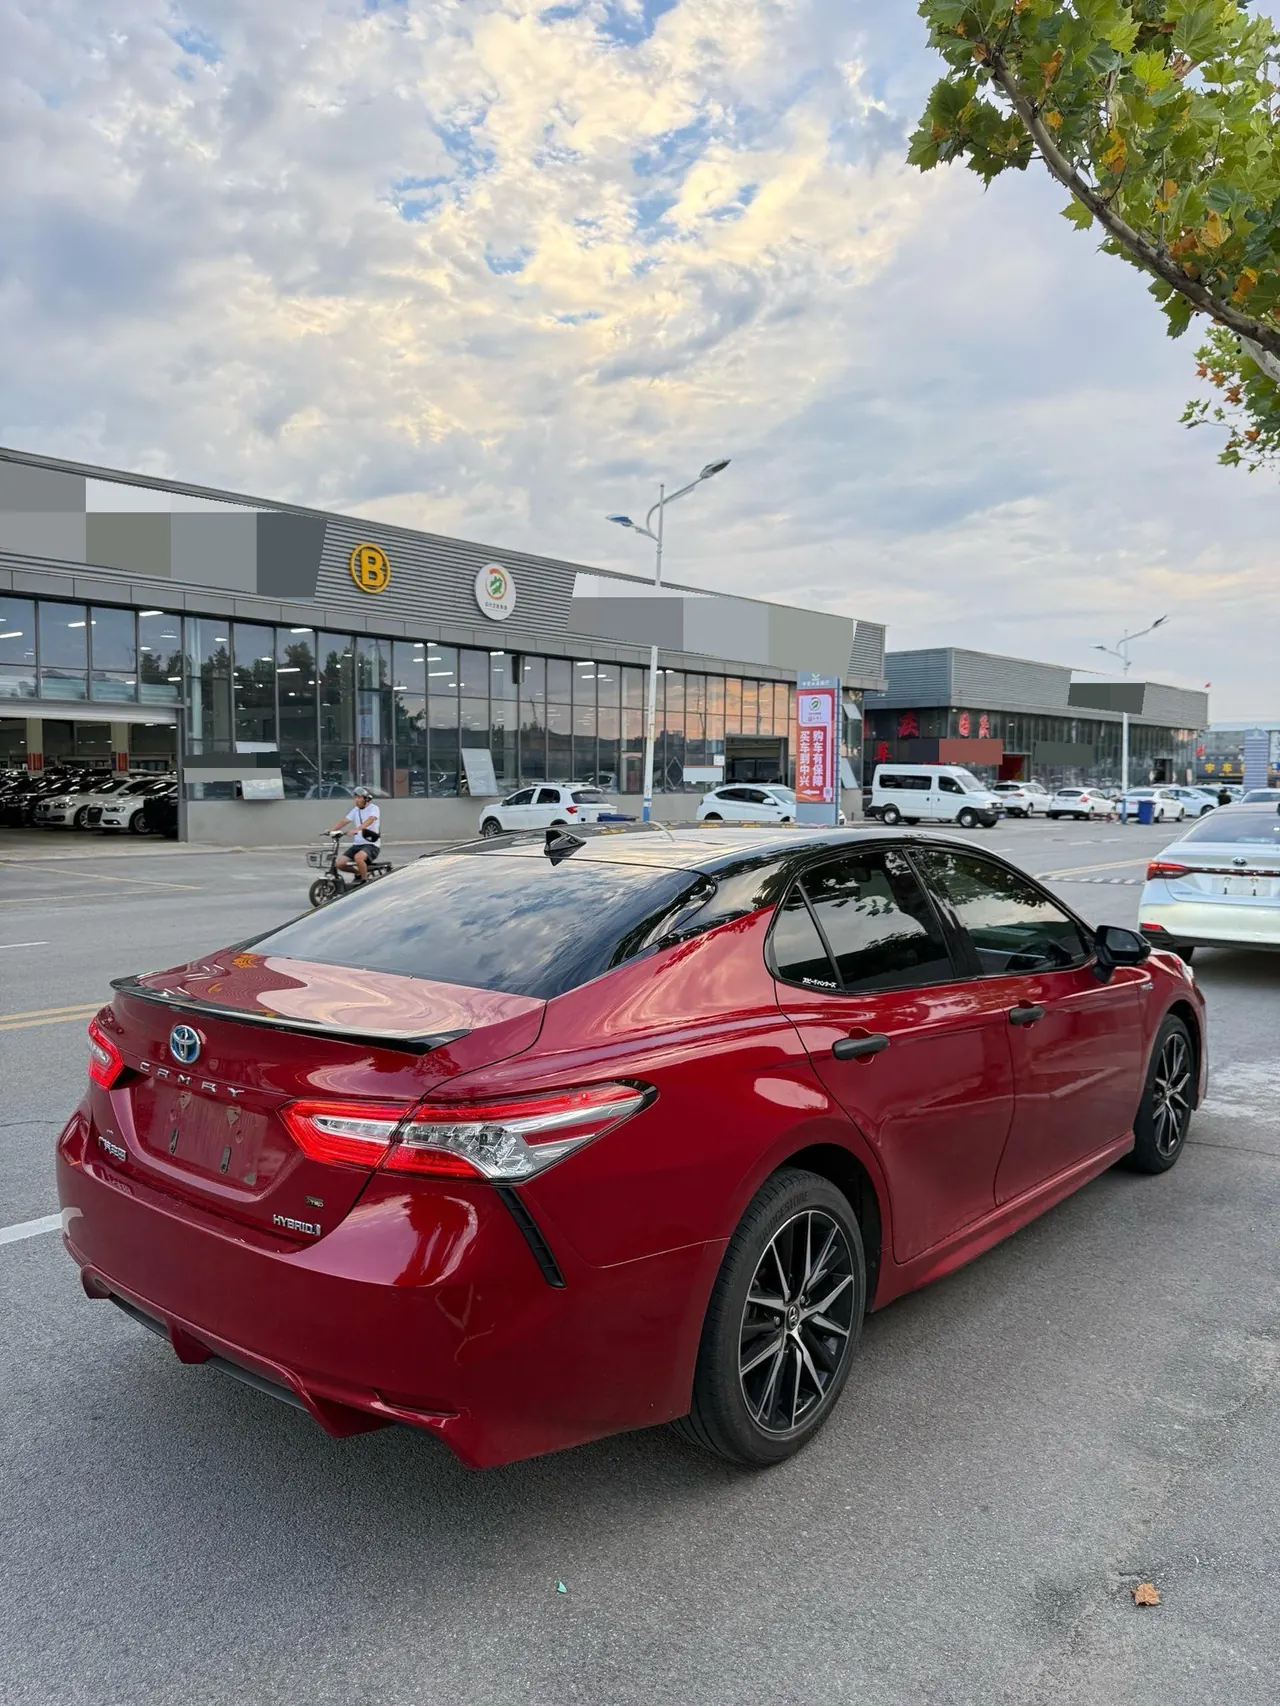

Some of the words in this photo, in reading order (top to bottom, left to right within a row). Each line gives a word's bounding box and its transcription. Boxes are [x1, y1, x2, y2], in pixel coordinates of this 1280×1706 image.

[799, 731, 811, 787] 买车到中兴
[812, 730, 824, 787] 购车有保障
[140, 1061, 245, 1097] CAMRY
